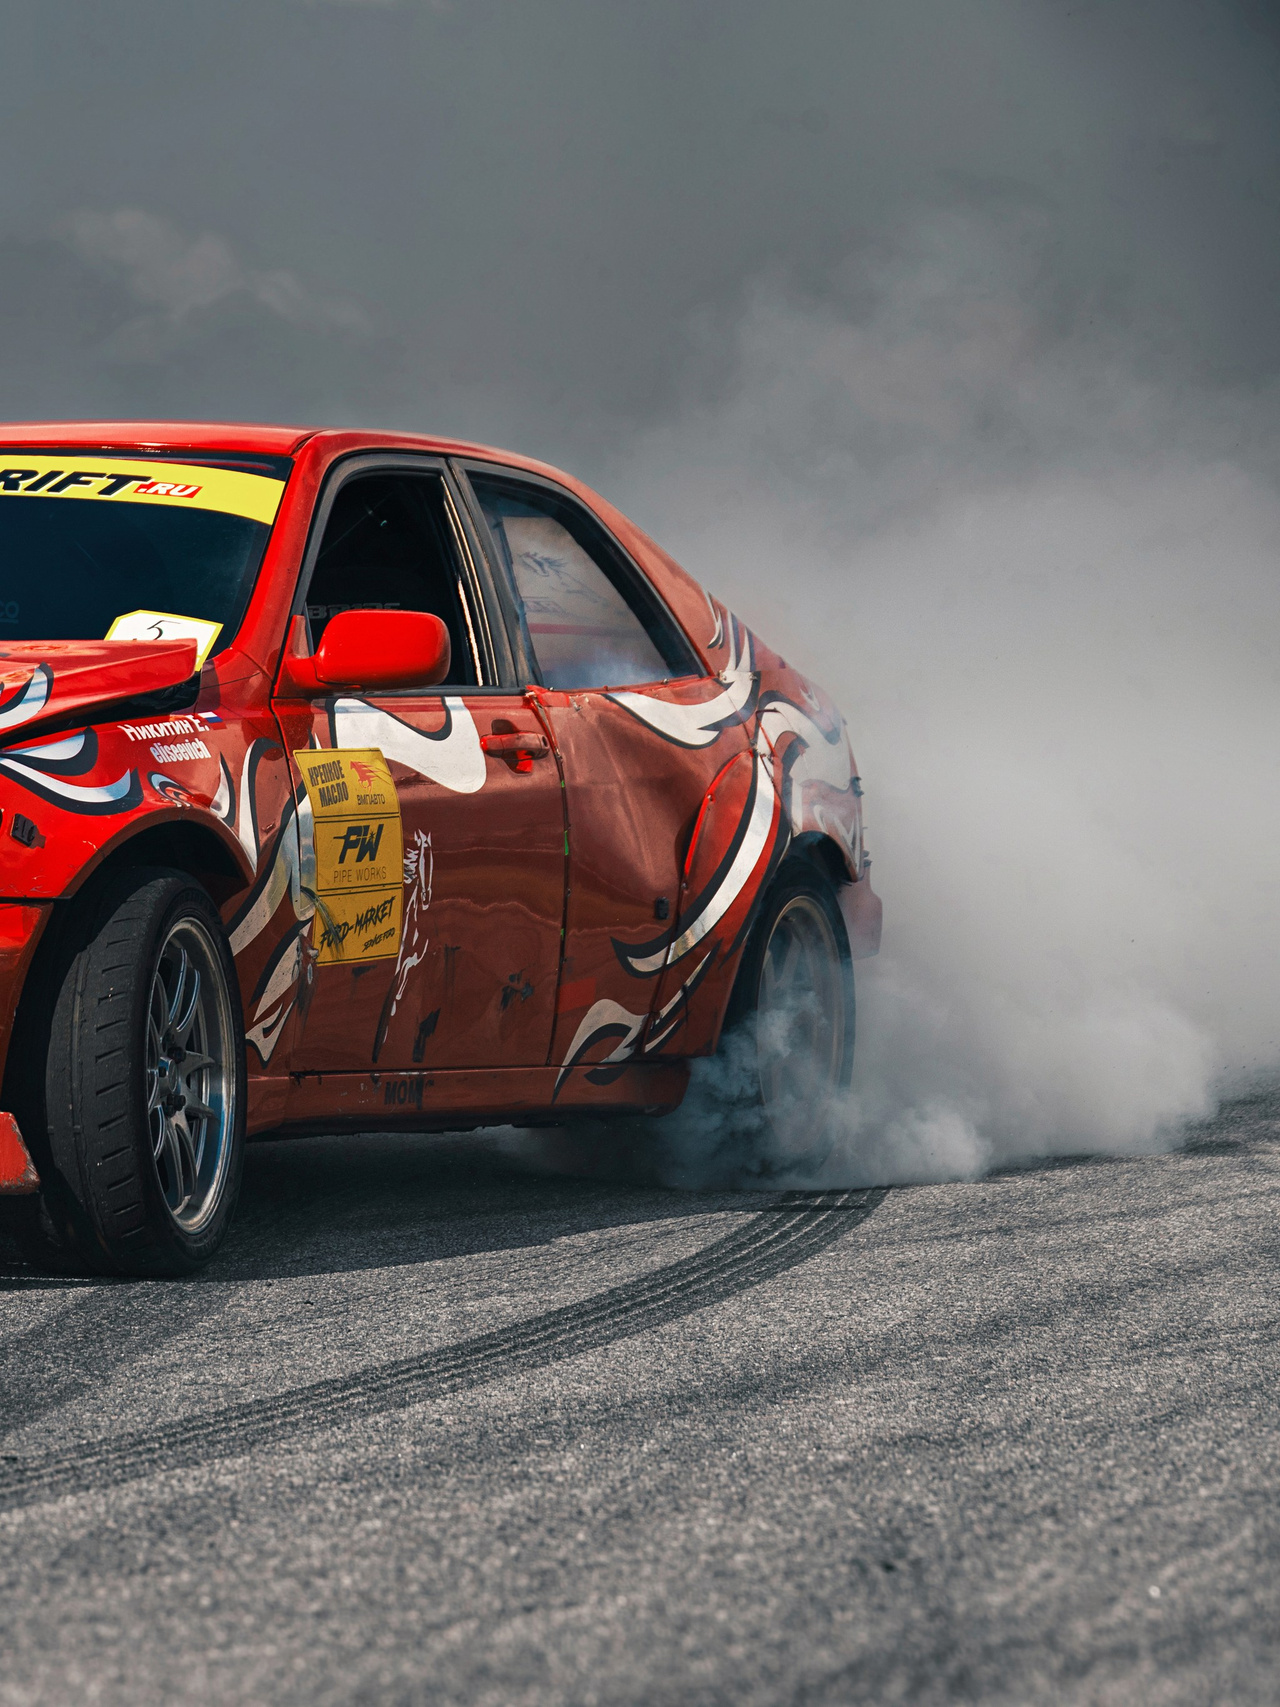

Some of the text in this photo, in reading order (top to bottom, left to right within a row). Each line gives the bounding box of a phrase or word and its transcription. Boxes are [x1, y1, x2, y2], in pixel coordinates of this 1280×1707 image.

[117, 719, 195, 742] Никитин
[150, 737, 211, 763] eliseevich
[307, 760, 345, 787] КРЕПКОЕ
[319, 781, 349, 808] МАСЛО
[357, 793, 386, 806] ВМПАВТО
[334, 824, 384, 864] PW
[333, 866, 386, 882] PIPE WORKS
[384, 1079, 435, 1106] MOM
